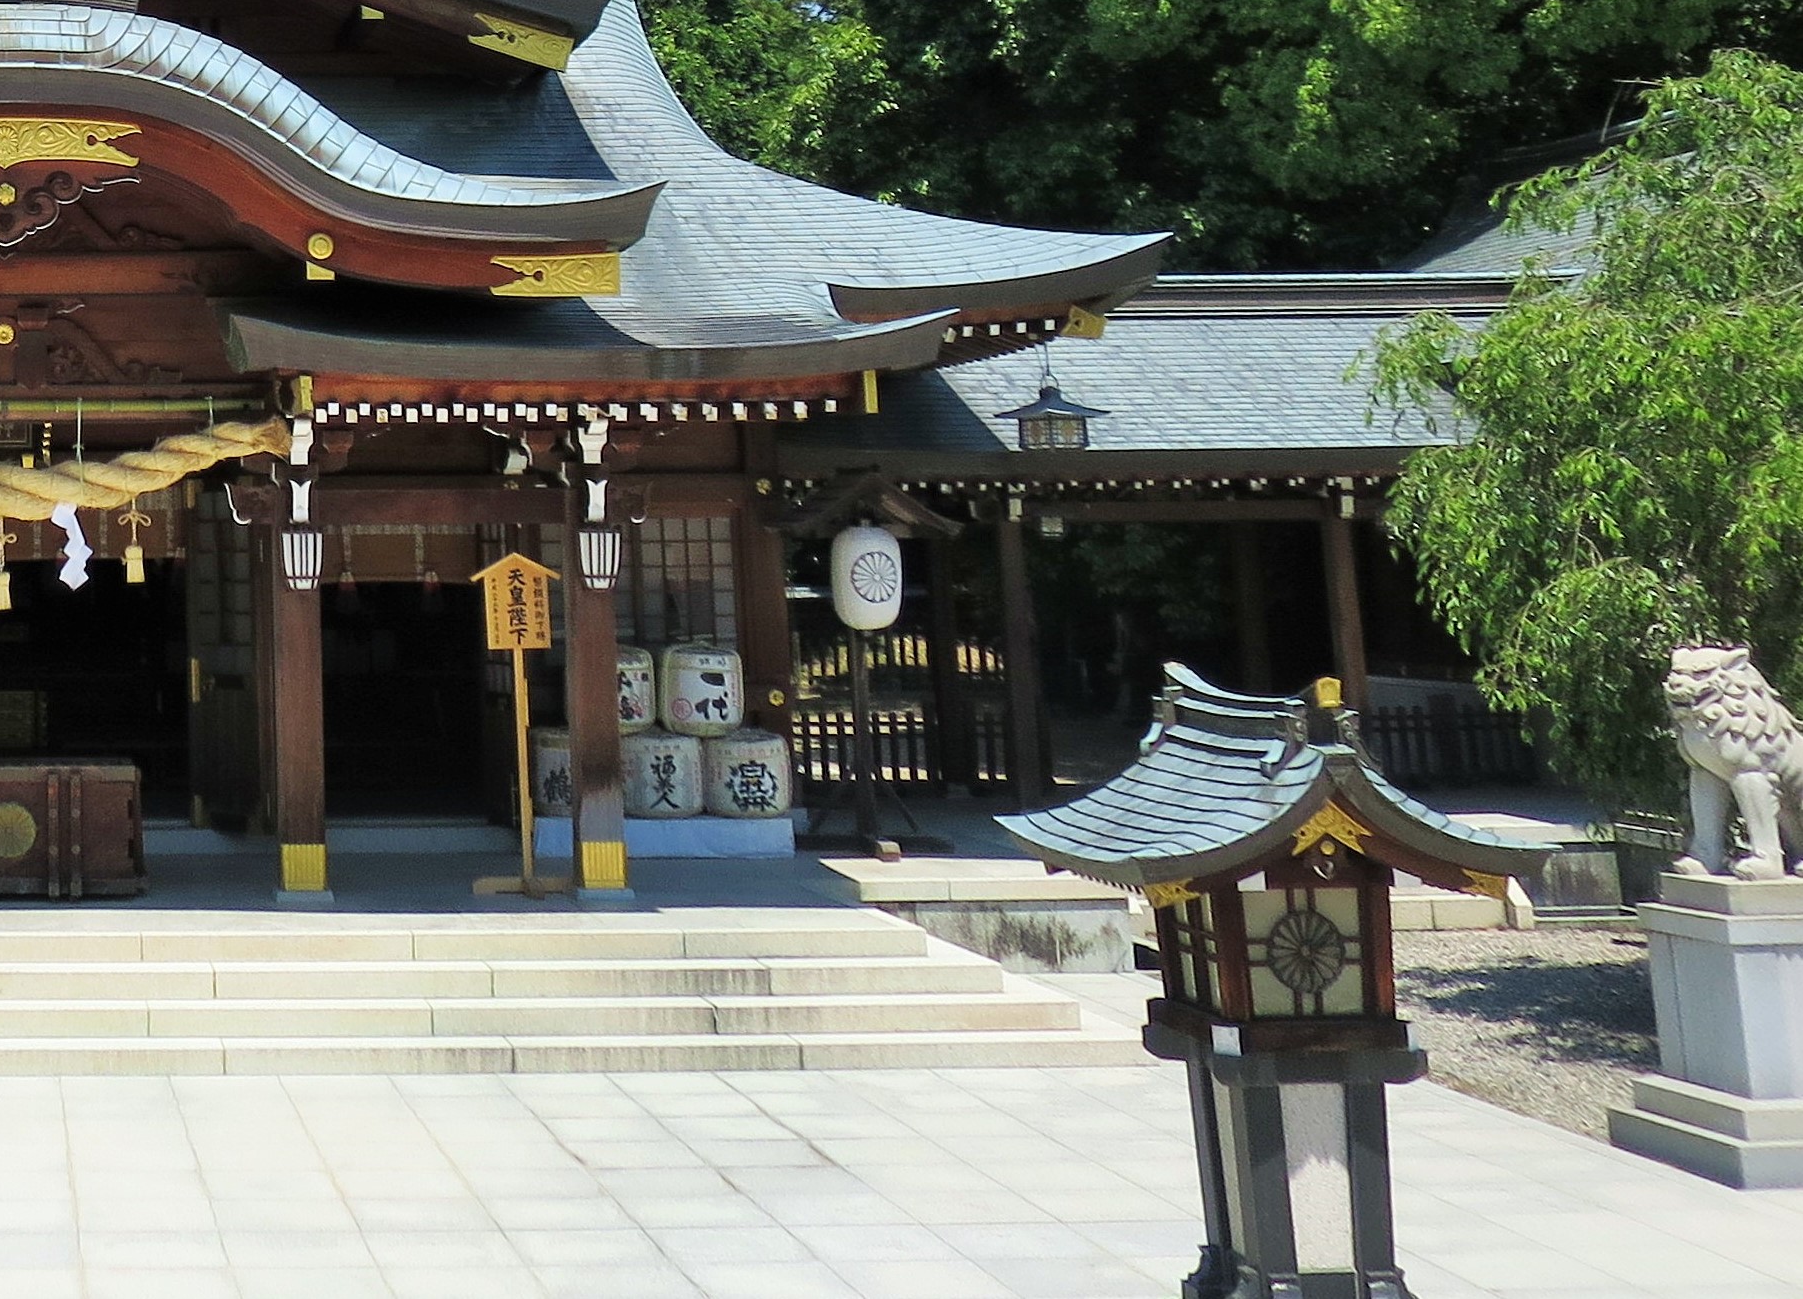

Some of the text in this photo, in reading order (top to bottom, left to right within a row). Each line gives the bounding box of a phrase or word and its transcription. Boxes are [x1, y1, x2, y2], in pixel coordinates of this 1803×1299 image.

[507, 568, 528, 645] 天皇陛下
[695, 672, 729, 721] 一代
[650, 754, 680, 810] 福美人
